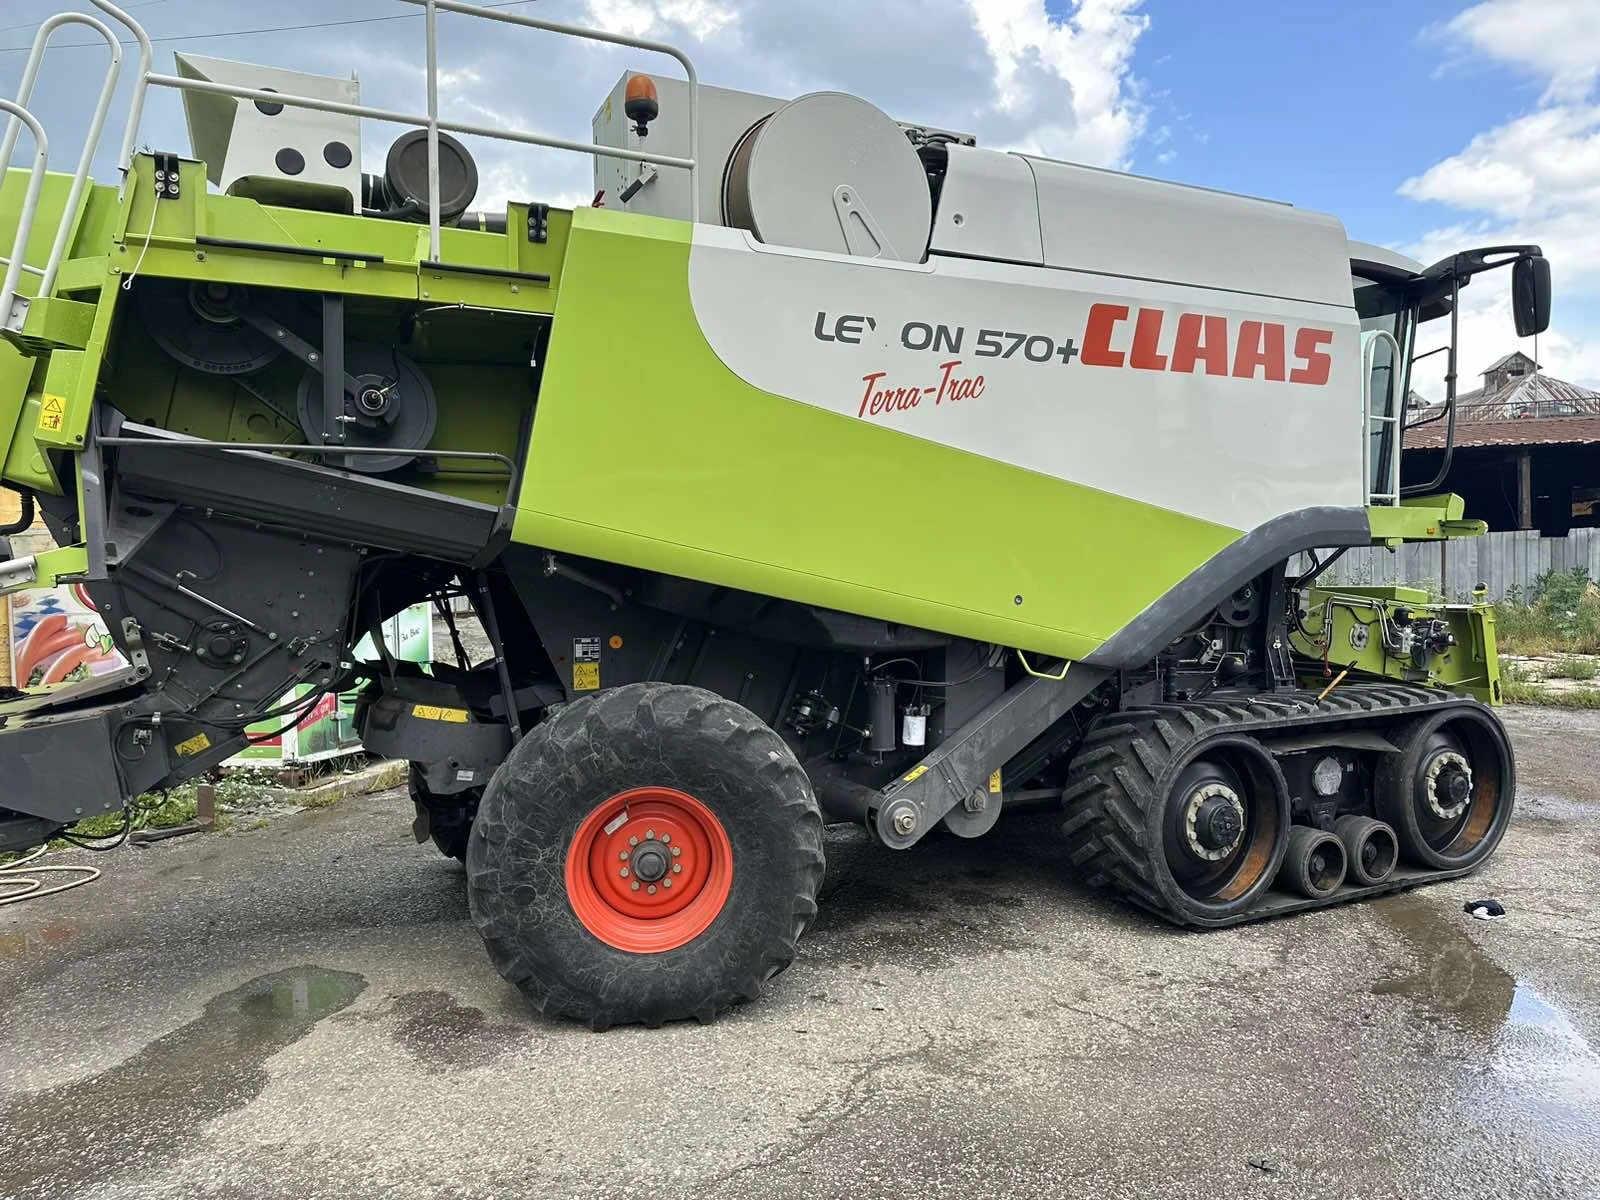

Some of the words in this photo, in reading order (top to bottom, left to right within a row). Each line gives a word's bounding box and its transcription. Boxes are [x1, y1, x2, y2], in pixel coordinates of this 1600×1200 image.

[974, 328, 1079, 364] 570+
[1080, 302, 1333, 385] CLAAS
[858, 360, 985, 418] Terra-Trac
